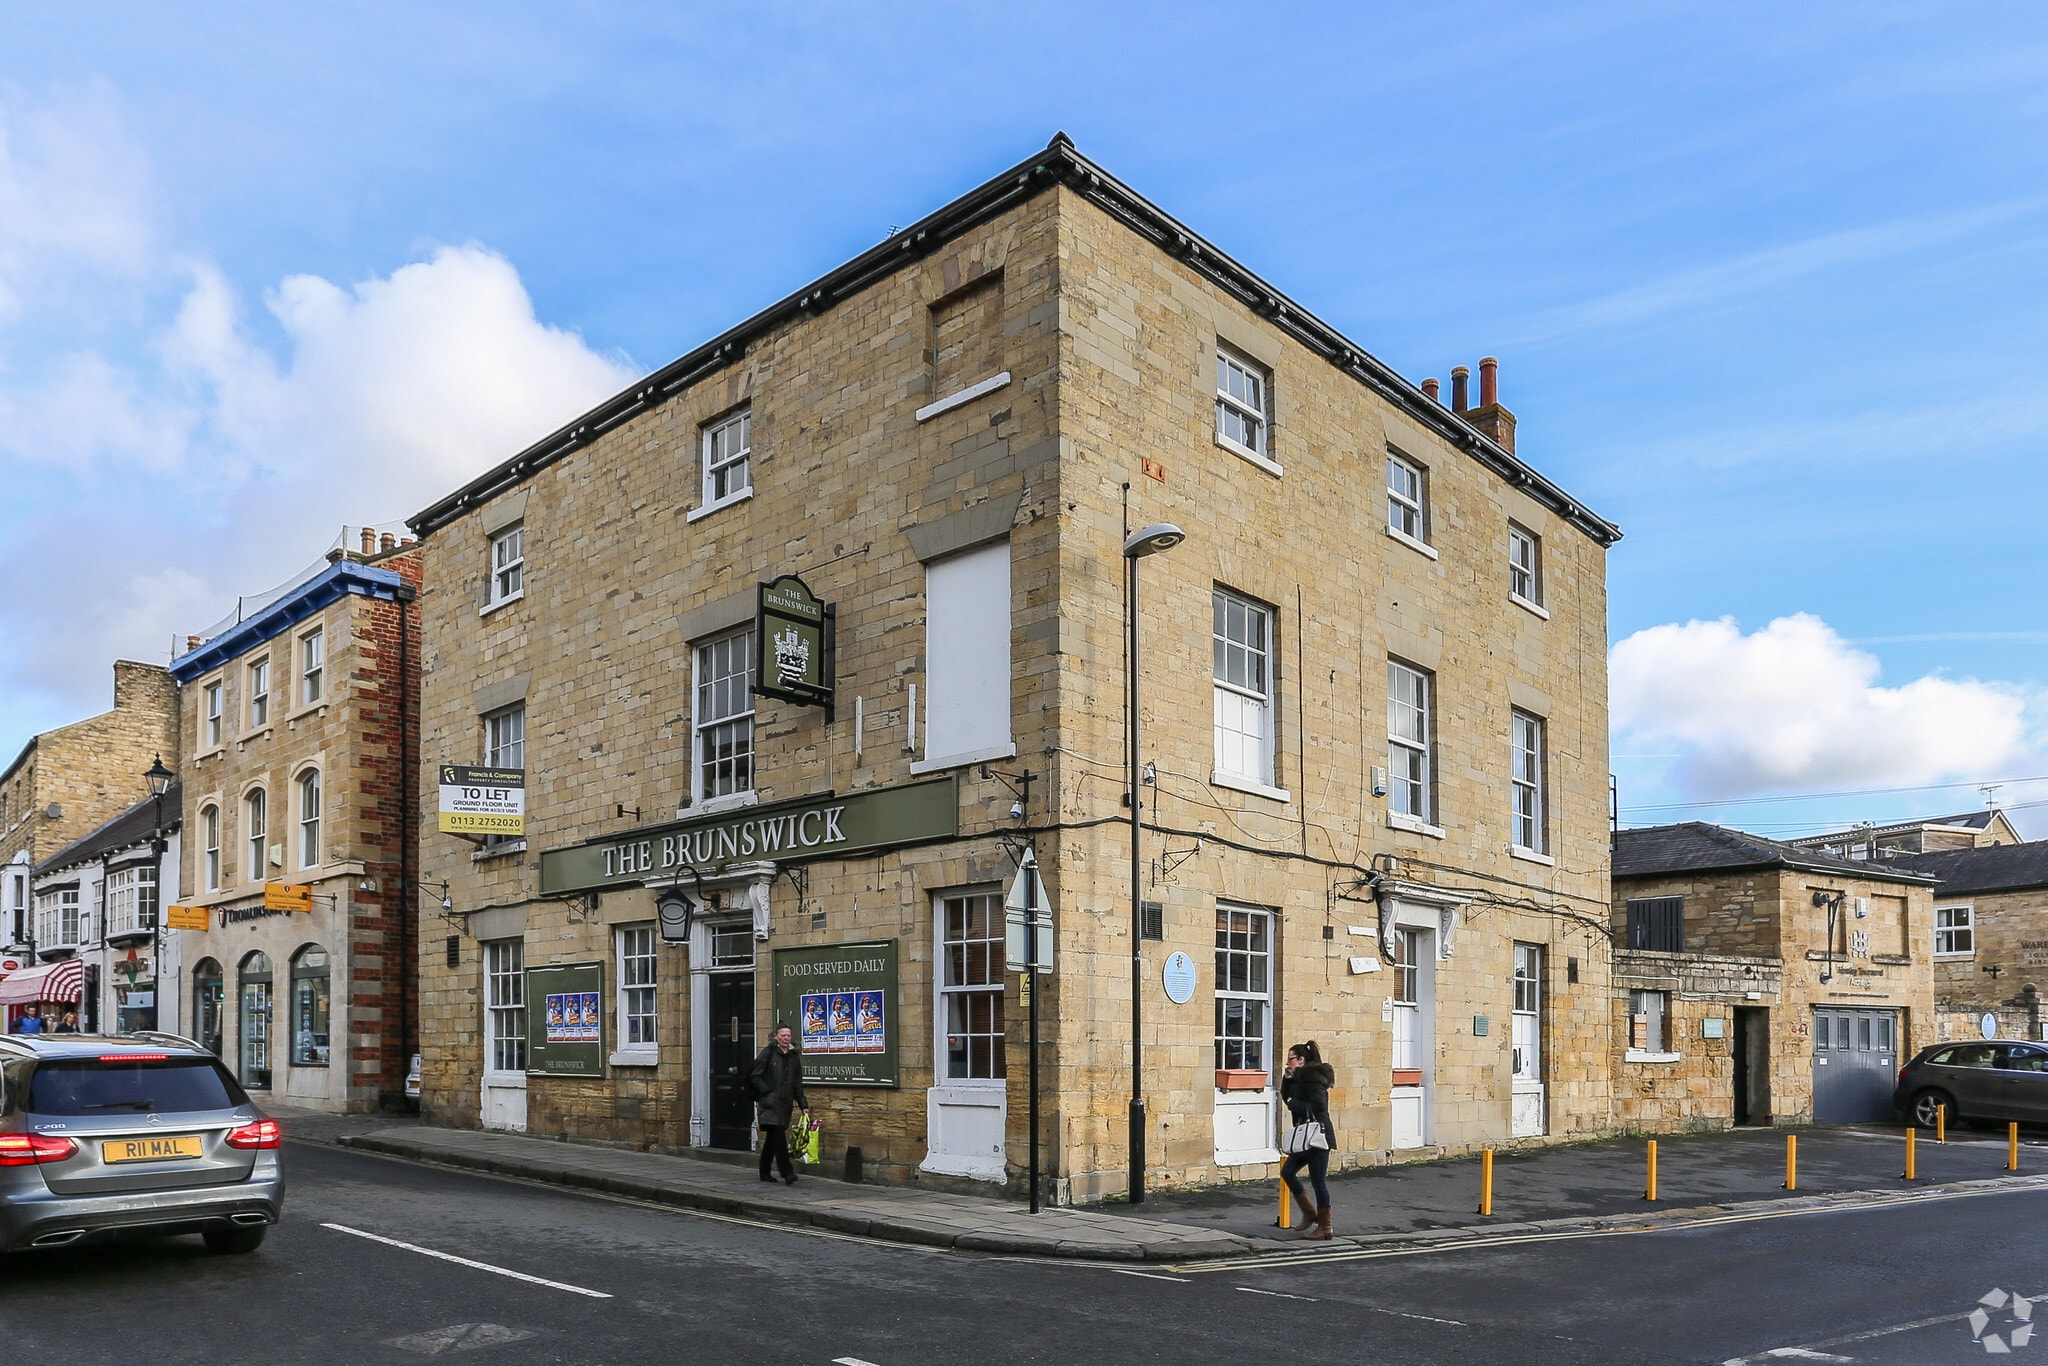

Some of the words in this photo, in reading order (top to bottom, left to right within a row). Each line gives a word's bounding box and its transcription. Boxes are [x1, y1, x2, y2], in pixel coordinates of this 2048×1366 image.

[784, 588, 802, 600] THE
[767, 594, 818, 616] BRUNSWICK
[461, 787, 481, 800] TO
[486, 788, 511, 801] LET
[450, 816, 475, 825] 0113
[478, 817, 521, 827] 2752020
[601, 840, 653, 878] THE
[661, 805, 847, 869] BRUNSWICK
[783, 964, 811, 977] FOOD
[813, 961, 852, 976] SERVED
[854, 958, 886, 973] DAILY
[803, 1066, 819, 1075] THE
[820, 1066, 866, 1076] BRUNSWICK
[151, 1140, 184, 1155] MAL
